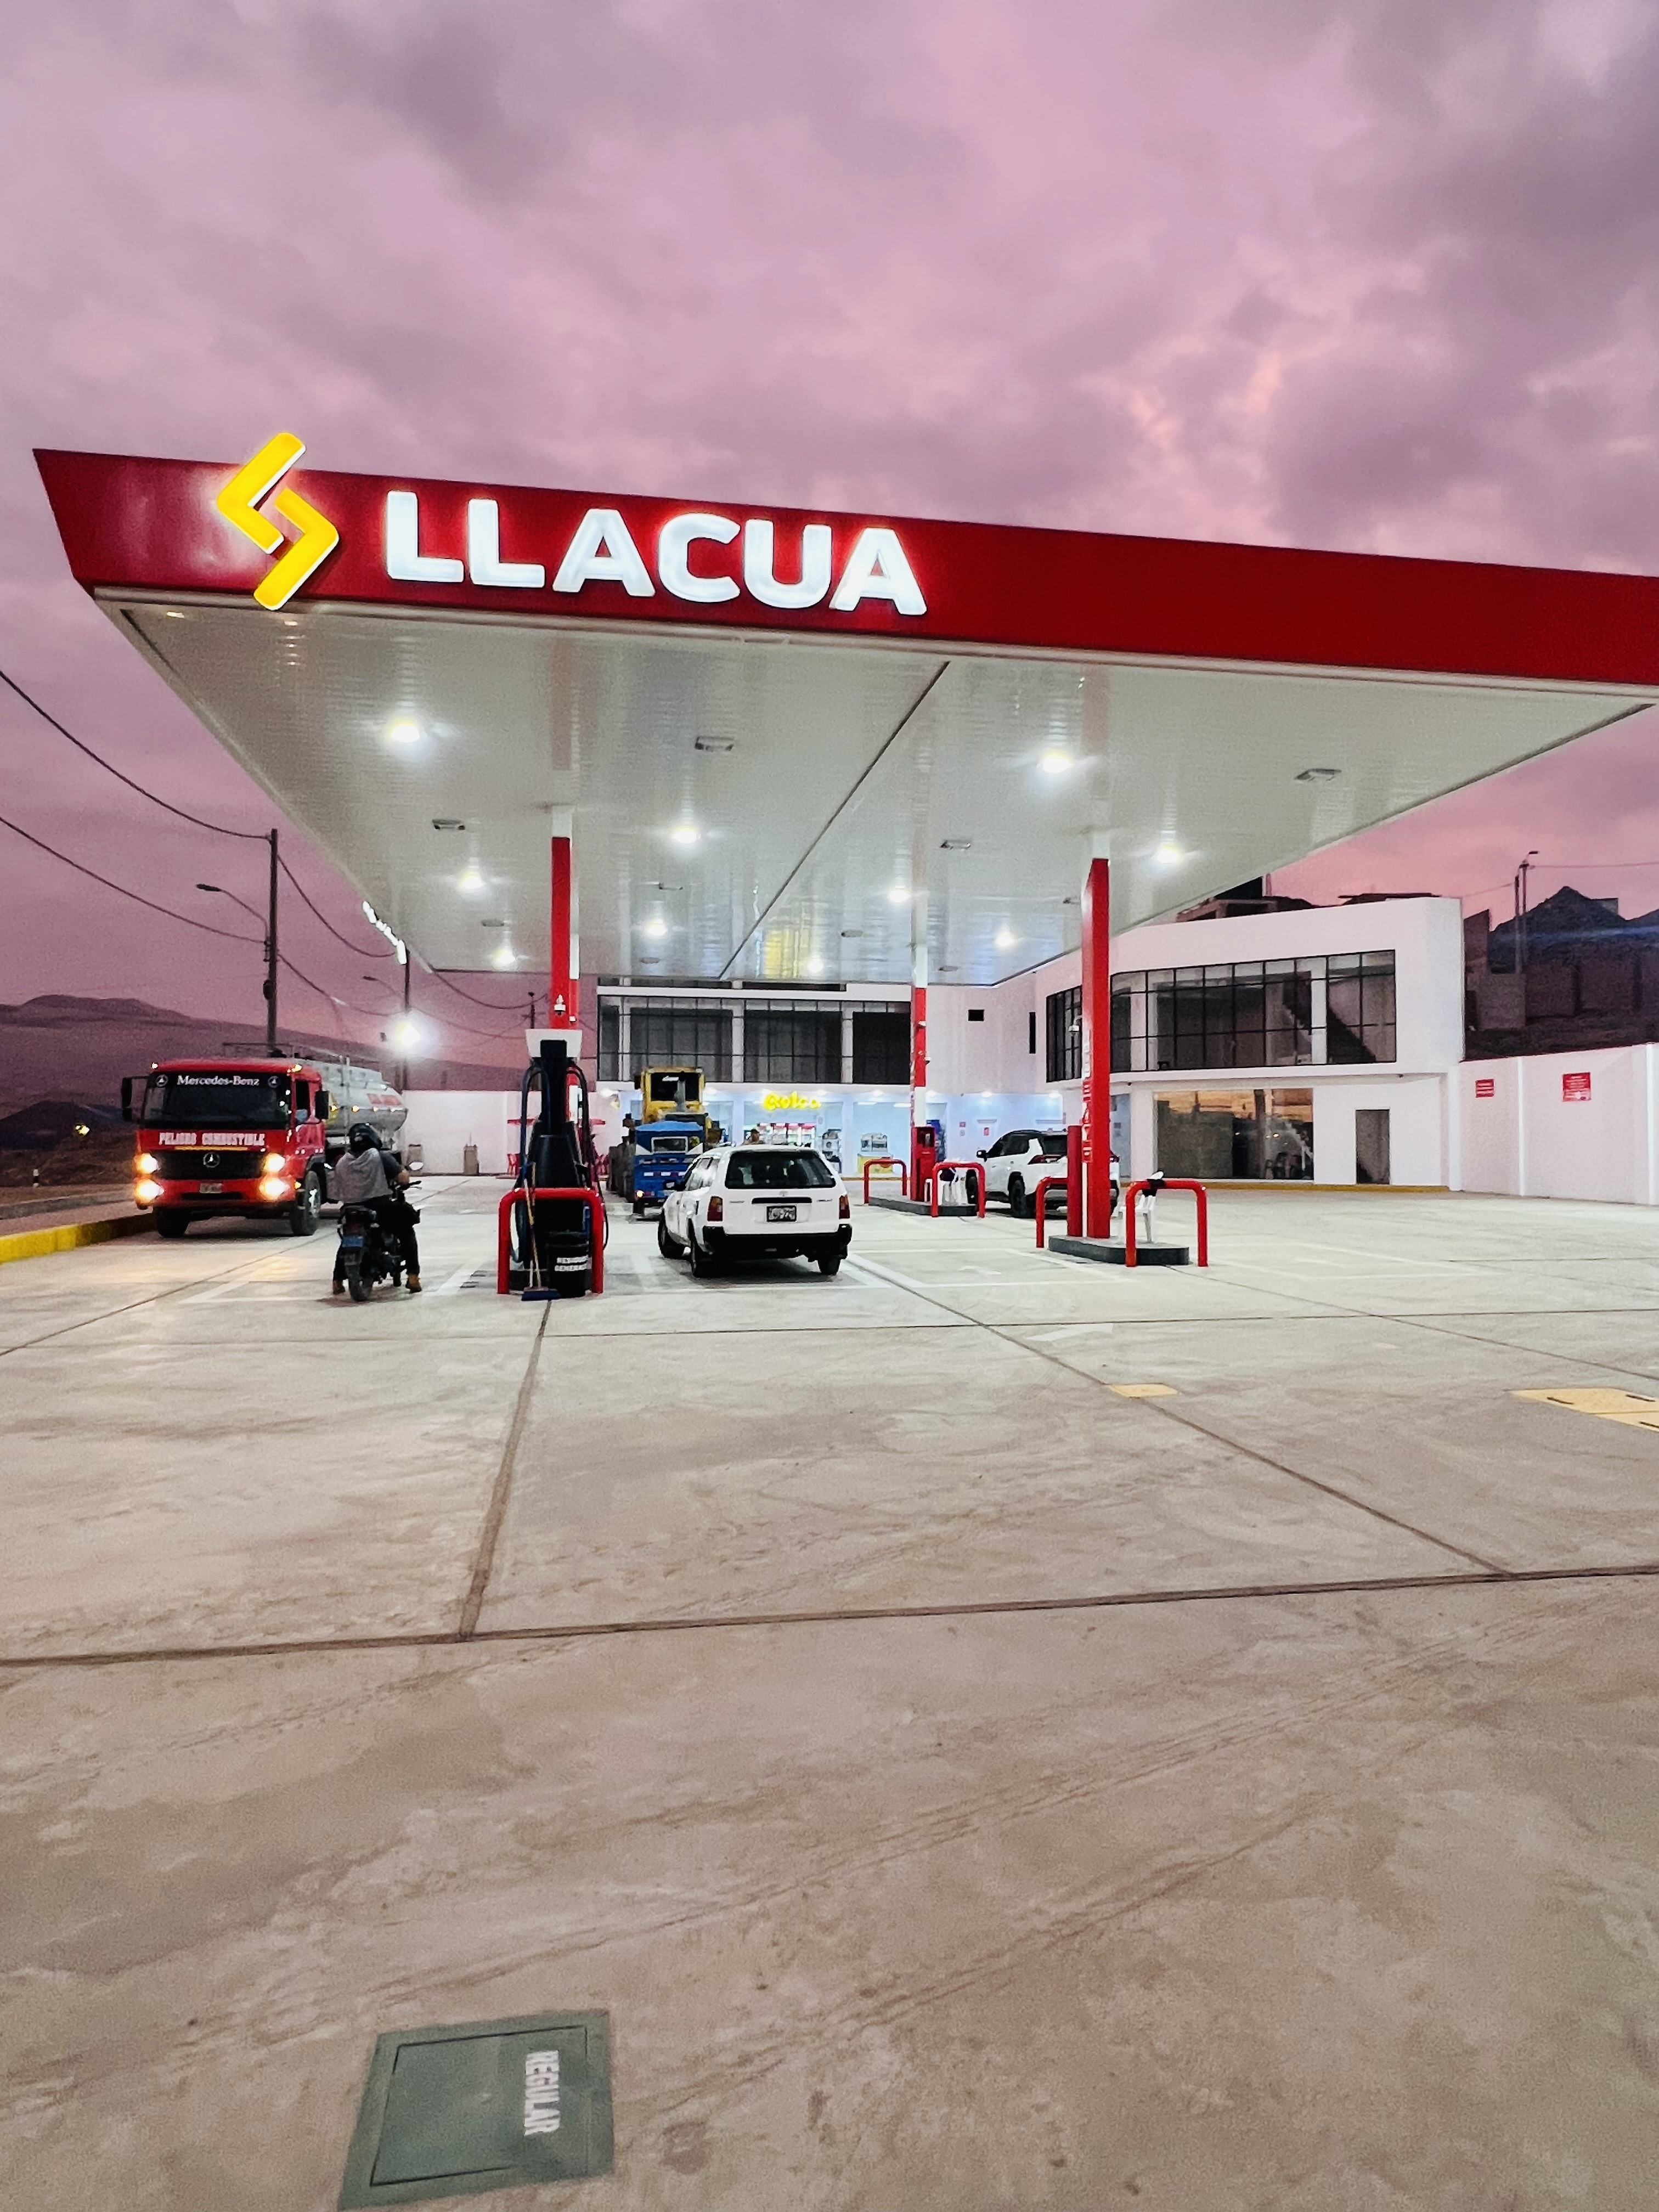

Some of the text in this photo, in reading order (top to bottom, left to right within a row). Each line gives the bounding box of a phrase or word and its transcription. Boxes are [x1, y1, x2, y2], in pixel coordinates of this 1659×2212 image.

[386, 489, 927, 616] LLACUA
[177, 1074, 260, 1086] Mercedes-Benz
[524, 2050, 560, 2136] REGULAR
